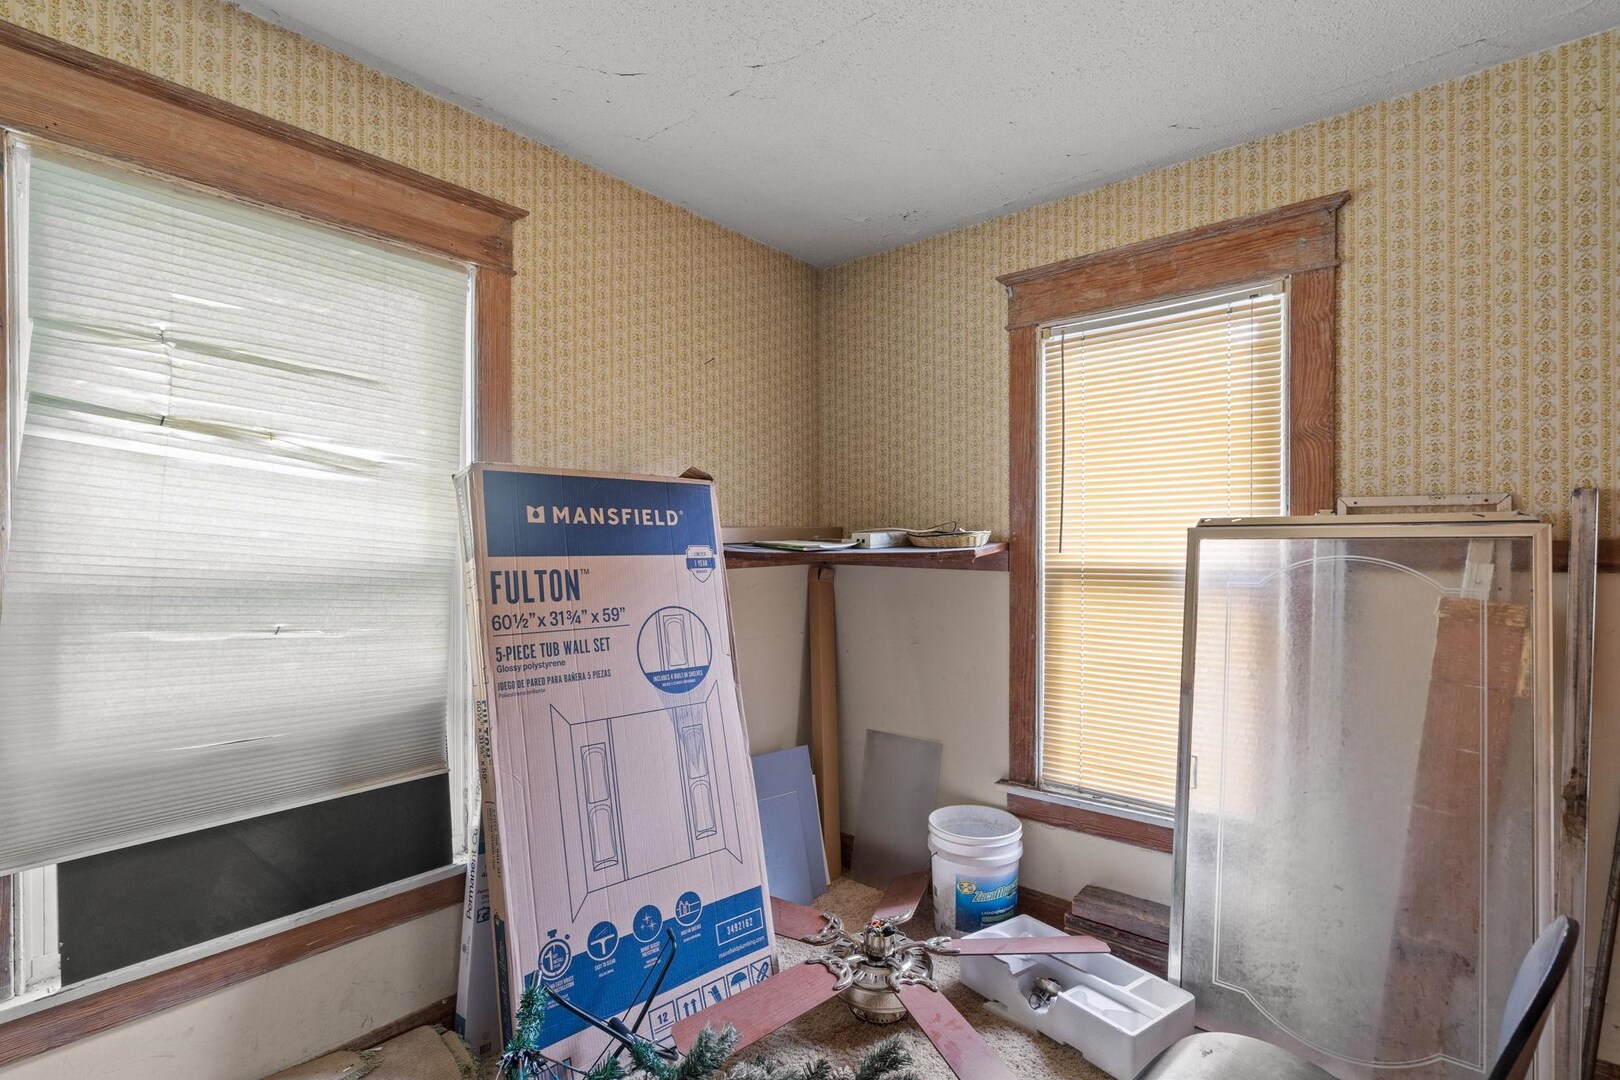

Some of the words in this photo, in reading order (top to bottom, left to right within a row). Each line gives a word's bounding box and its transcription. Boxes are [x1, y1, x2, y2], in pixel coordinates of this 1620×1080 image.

[552, 506, 680, 526] MANSFIELD
[538, 616, 546, 627] x
[591, 612, 599, 623] x
[602, 607, 625, 623] 59"
[495, 643, 537, 662] 5-PIECE
[540, 642, 560, 658] TUB
[563, 639, 590, 655] WALL
[593, 637, 610, 652] SET
[496, 663, 521, 673] Glossy
[523, 659, 566, 671] polystyrene
[498, 681, 515, 691] JUEGO
[516, 680, 525, 689] DE
[526, 677, 546, 687] PARED
[547, 675, 563, 684] PARA
[564, 671, 586, 682] BAÑERA
[587, 671, 592, 680] 5
[592, 669, 612, 679] PIEZAS
[466, 849, 477, 919] Permanent
[726, 917, 753, 935] 3492162
[657, 1011, 669, 1025] 12
